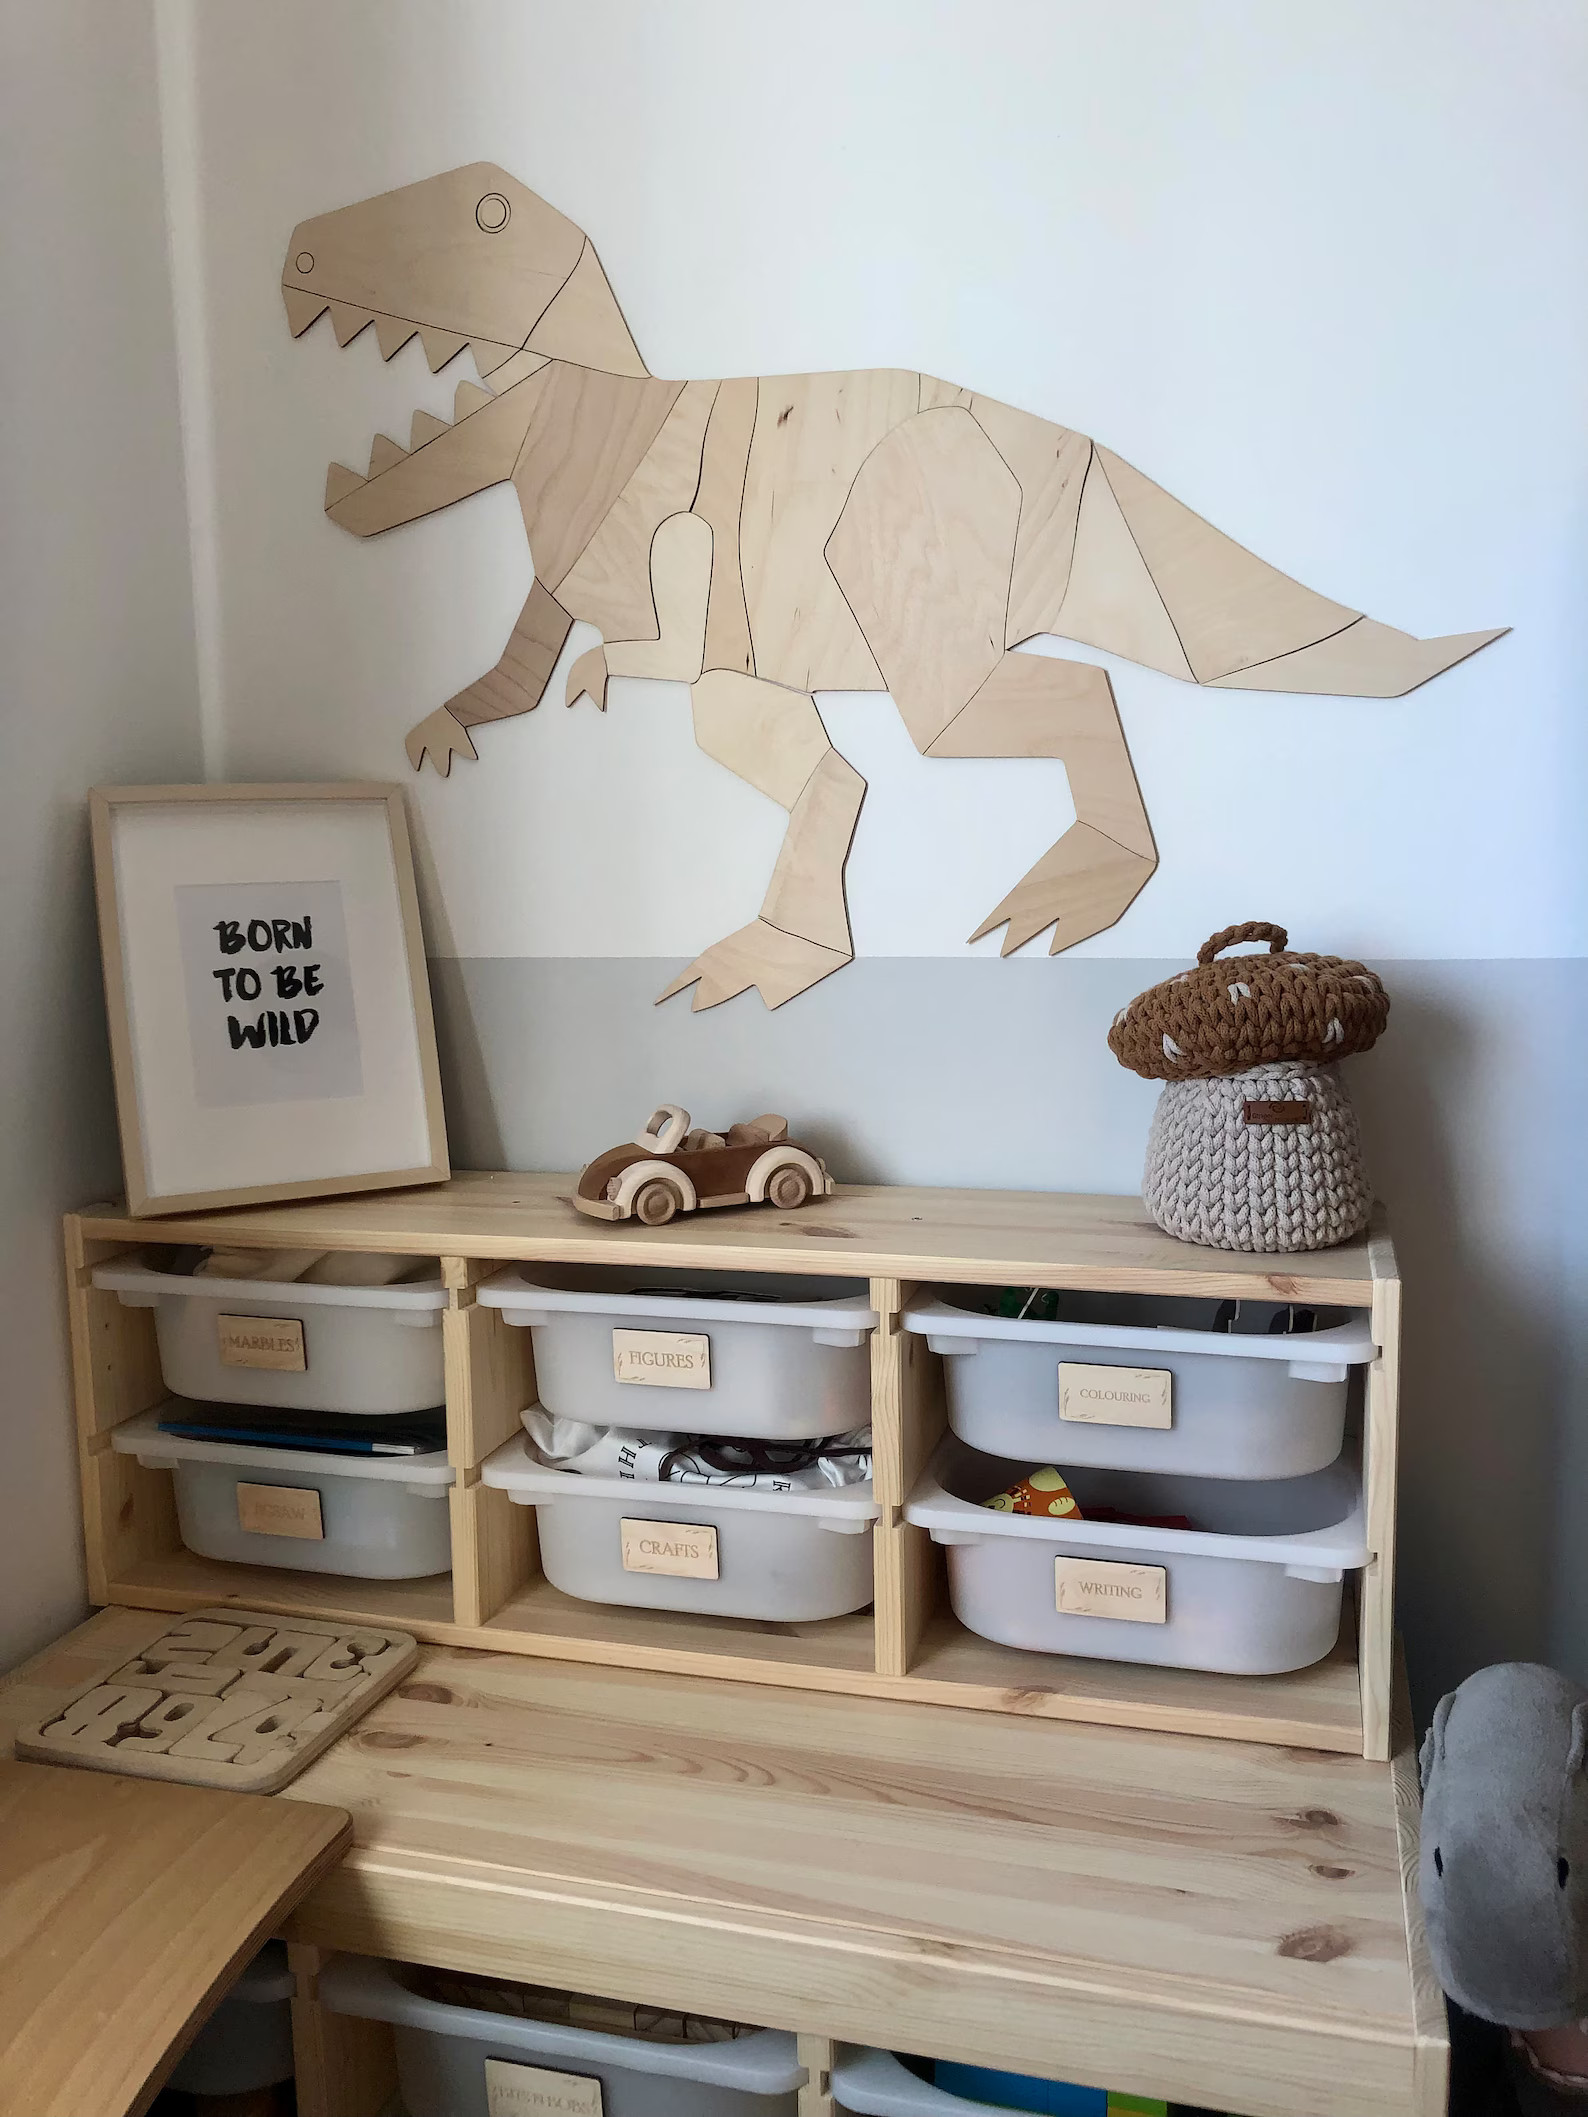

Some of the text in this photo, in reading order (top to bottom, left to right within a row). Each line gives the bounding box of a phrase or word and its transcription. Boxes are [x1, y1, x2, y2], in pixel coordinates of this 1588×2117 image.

[212, 915, 313, 955] BORN
[212, 963, 325, 1003] TO BE
[227, 1008, 320, 1050] WILD
[228, 1335, 295, 1353] MARBLES
[628, 1350, 694, 1369] FIGURES
[1079, 1388, 1151, 1404] COLOURING
[639, 1539, 699, 1559] CRAFTS
[1078, 1581, 1143, 1600] WRITING
